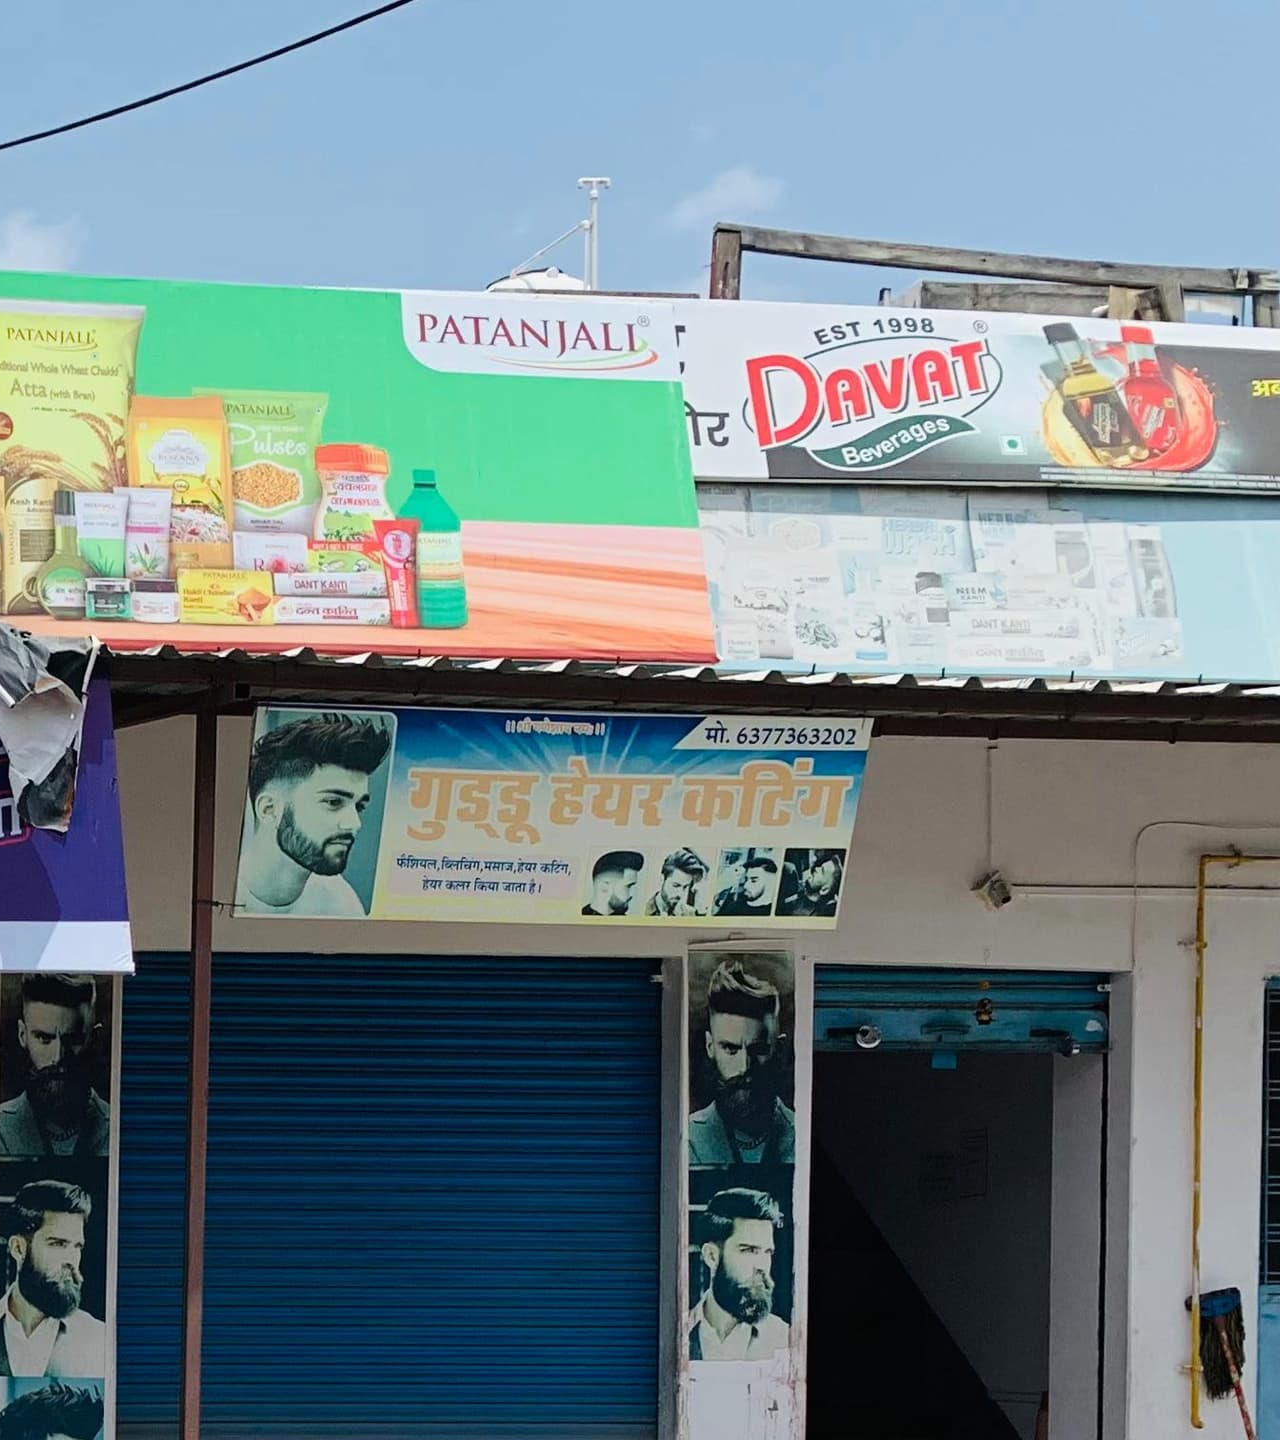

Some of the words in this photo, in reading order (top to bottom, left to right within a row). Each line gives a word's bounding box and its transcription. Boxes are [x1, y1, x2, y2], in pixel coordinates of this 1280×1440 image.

[6, 328, 93, 344] PATANJALI
[416, 311, 638, 357] PATANJALI
[813, 321, 860, 345] EST
[873, 317, 935, 335] 1998
[31, 361, 58, 374] Whole
[60, 363, 88, 376] Wheat
[10, 379, 47, 398] Atta
[224, 403, 295, 418] PATANJALI
[227, 423, 308, 457] Pulses
[841, 415, 951, 467] Beverages
[294, 580, 319, 591] DANT
[321, 580, 348, 592] KANTI
[735, 726, 858, 746] 6377363202
[548, 756, 675, 828] हेयर
[680, 757, 855, 829] कटिंग
